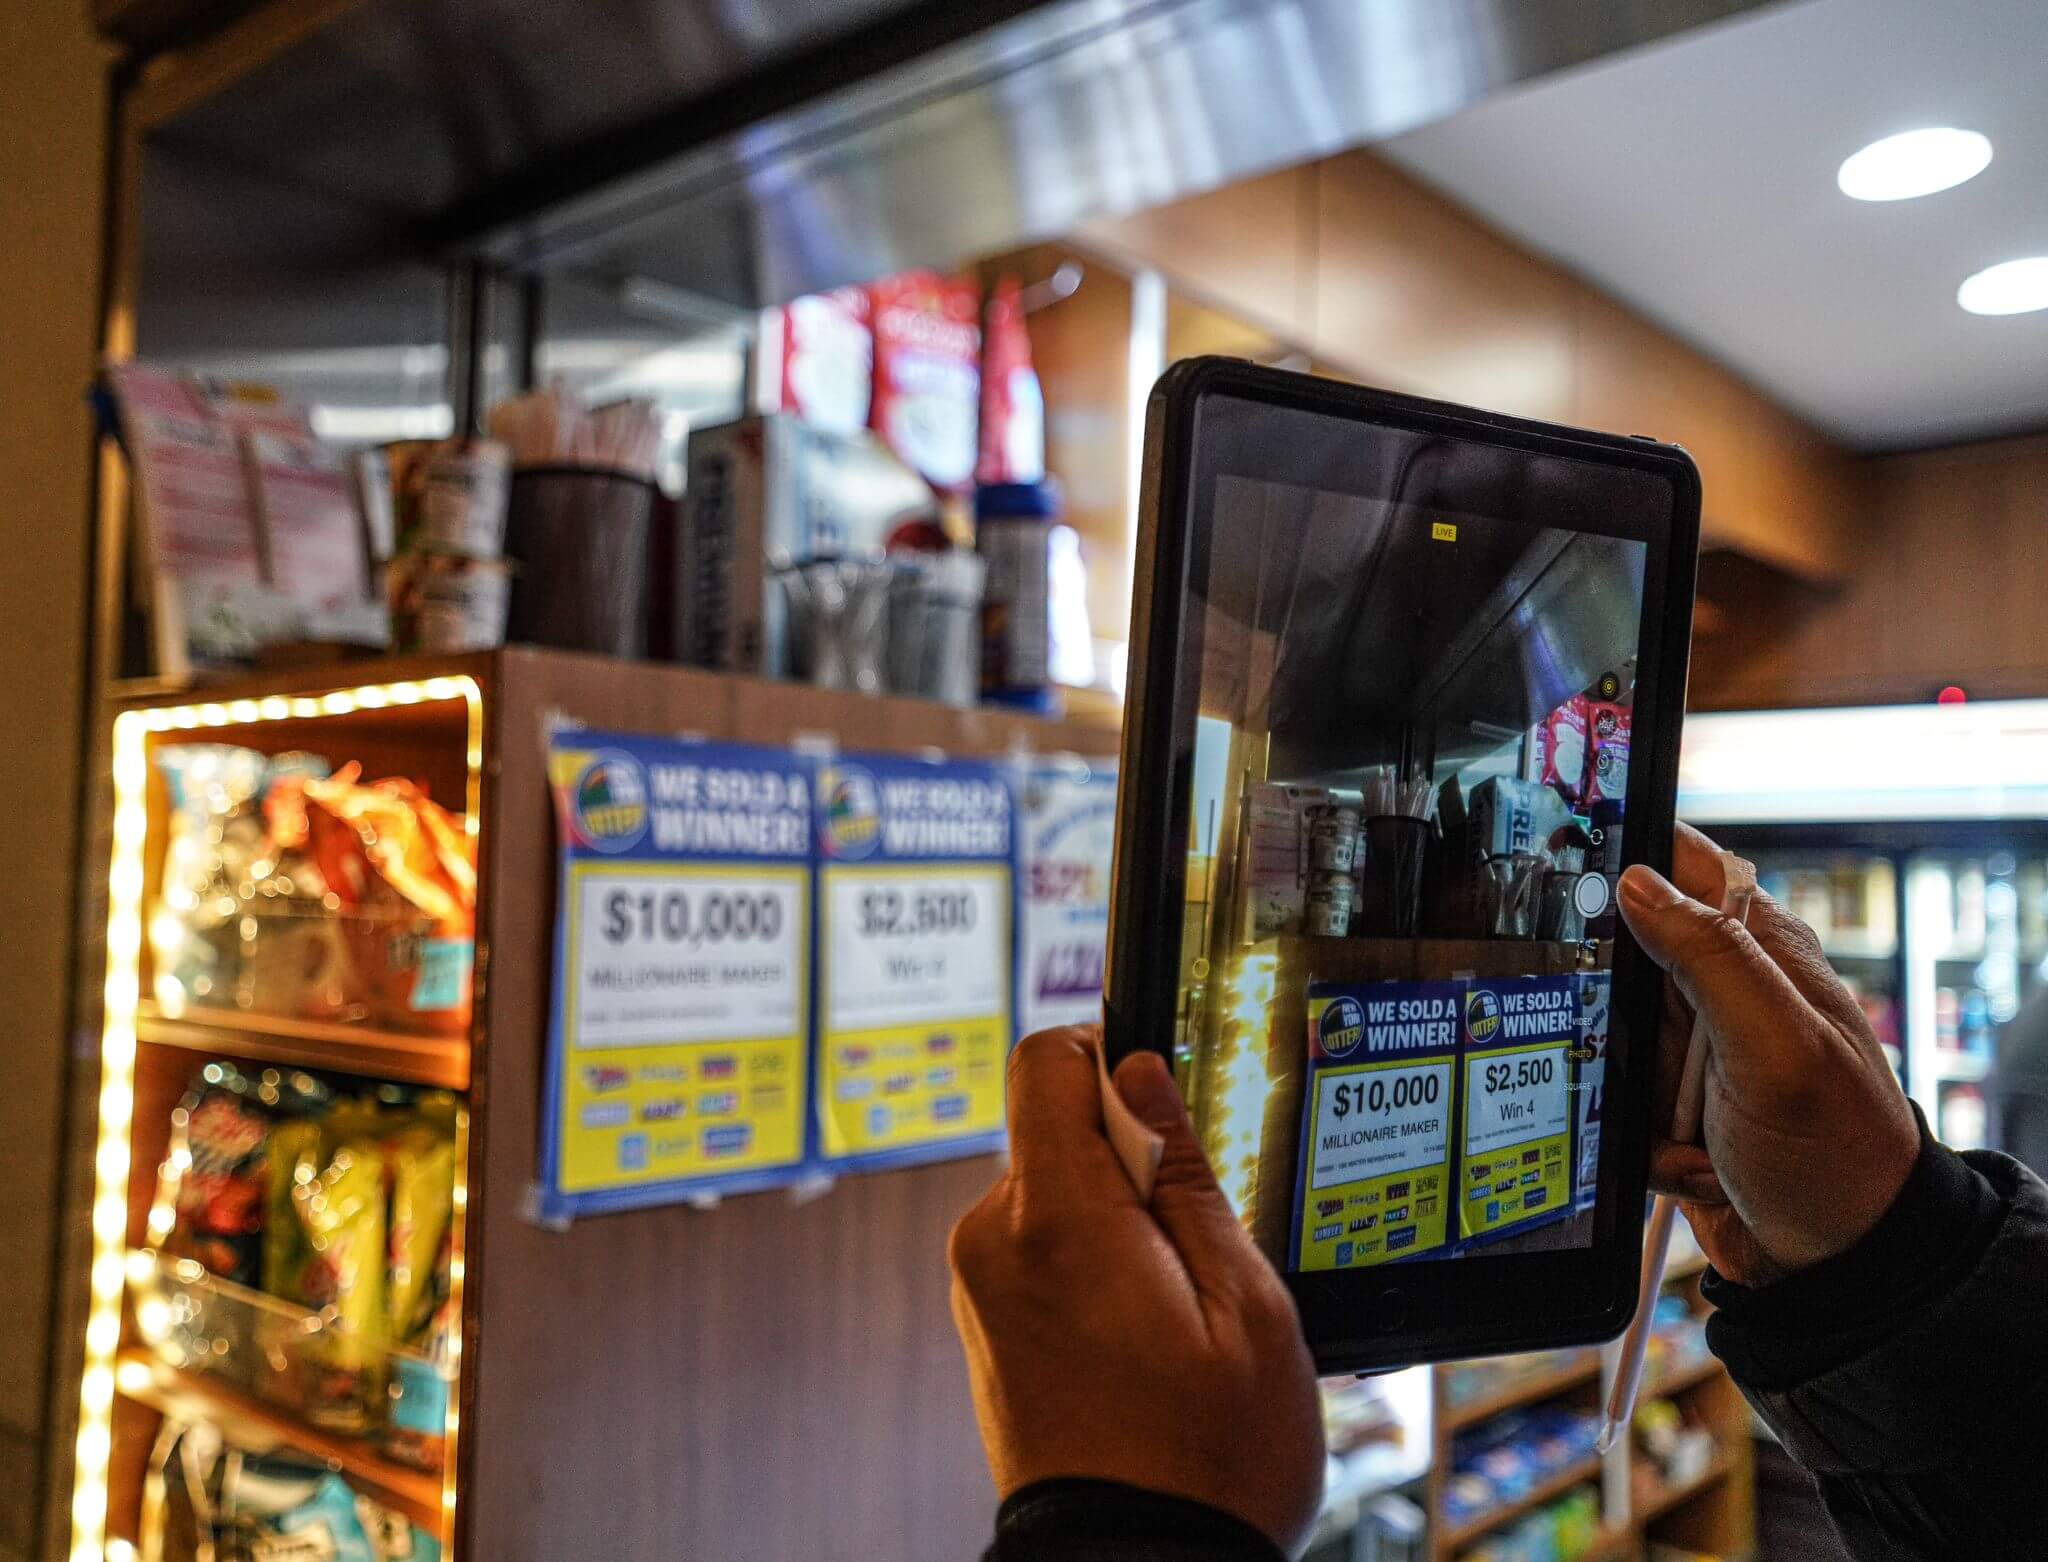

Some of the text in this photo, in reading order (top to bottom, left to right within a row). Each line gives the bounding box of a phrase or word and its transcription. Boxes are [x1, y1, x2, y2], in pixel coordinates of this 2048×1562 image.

[1435, 527, 1454, 538] LIVE
[654, 763, 699, 803] WE
[703, 766, 787, 808] SOLD
[788, 772, 809, 810] A
[653, 806, 810, 855] WINNER!
[604, 886, 783, 950] $10,000
[1368, 1001, 1395, 1023] WE
[1399, 999, 1443, 1021] SOLD
[1446, 998, 1457, 1018] A
[1503, 994, 1524, 1013] WE
[1526, 991, 1561, 1012] SOLD
[1563, 990, 1573, 1008] A
[1503, 1010, 1573, 1038] WINNER!
[1572, 1017, 1593, 1026] VIDEO
[1367, 1021, 1456, 1052] WINNER!
[1568, 1050, 1592, 1059] PHOTO
[1485, 1057, 1553, 1095] $2,500
[1562, 1081, 1592, 1092] SQUARE
[1333, 1073, 1439, 1120] $10,000
[1500, 1100, 1535, 1121] Win 4
[1322, 1125, 1398, 1151] MILLIONAIRE
[1401, 1119, 1439, 1137] MAKER
